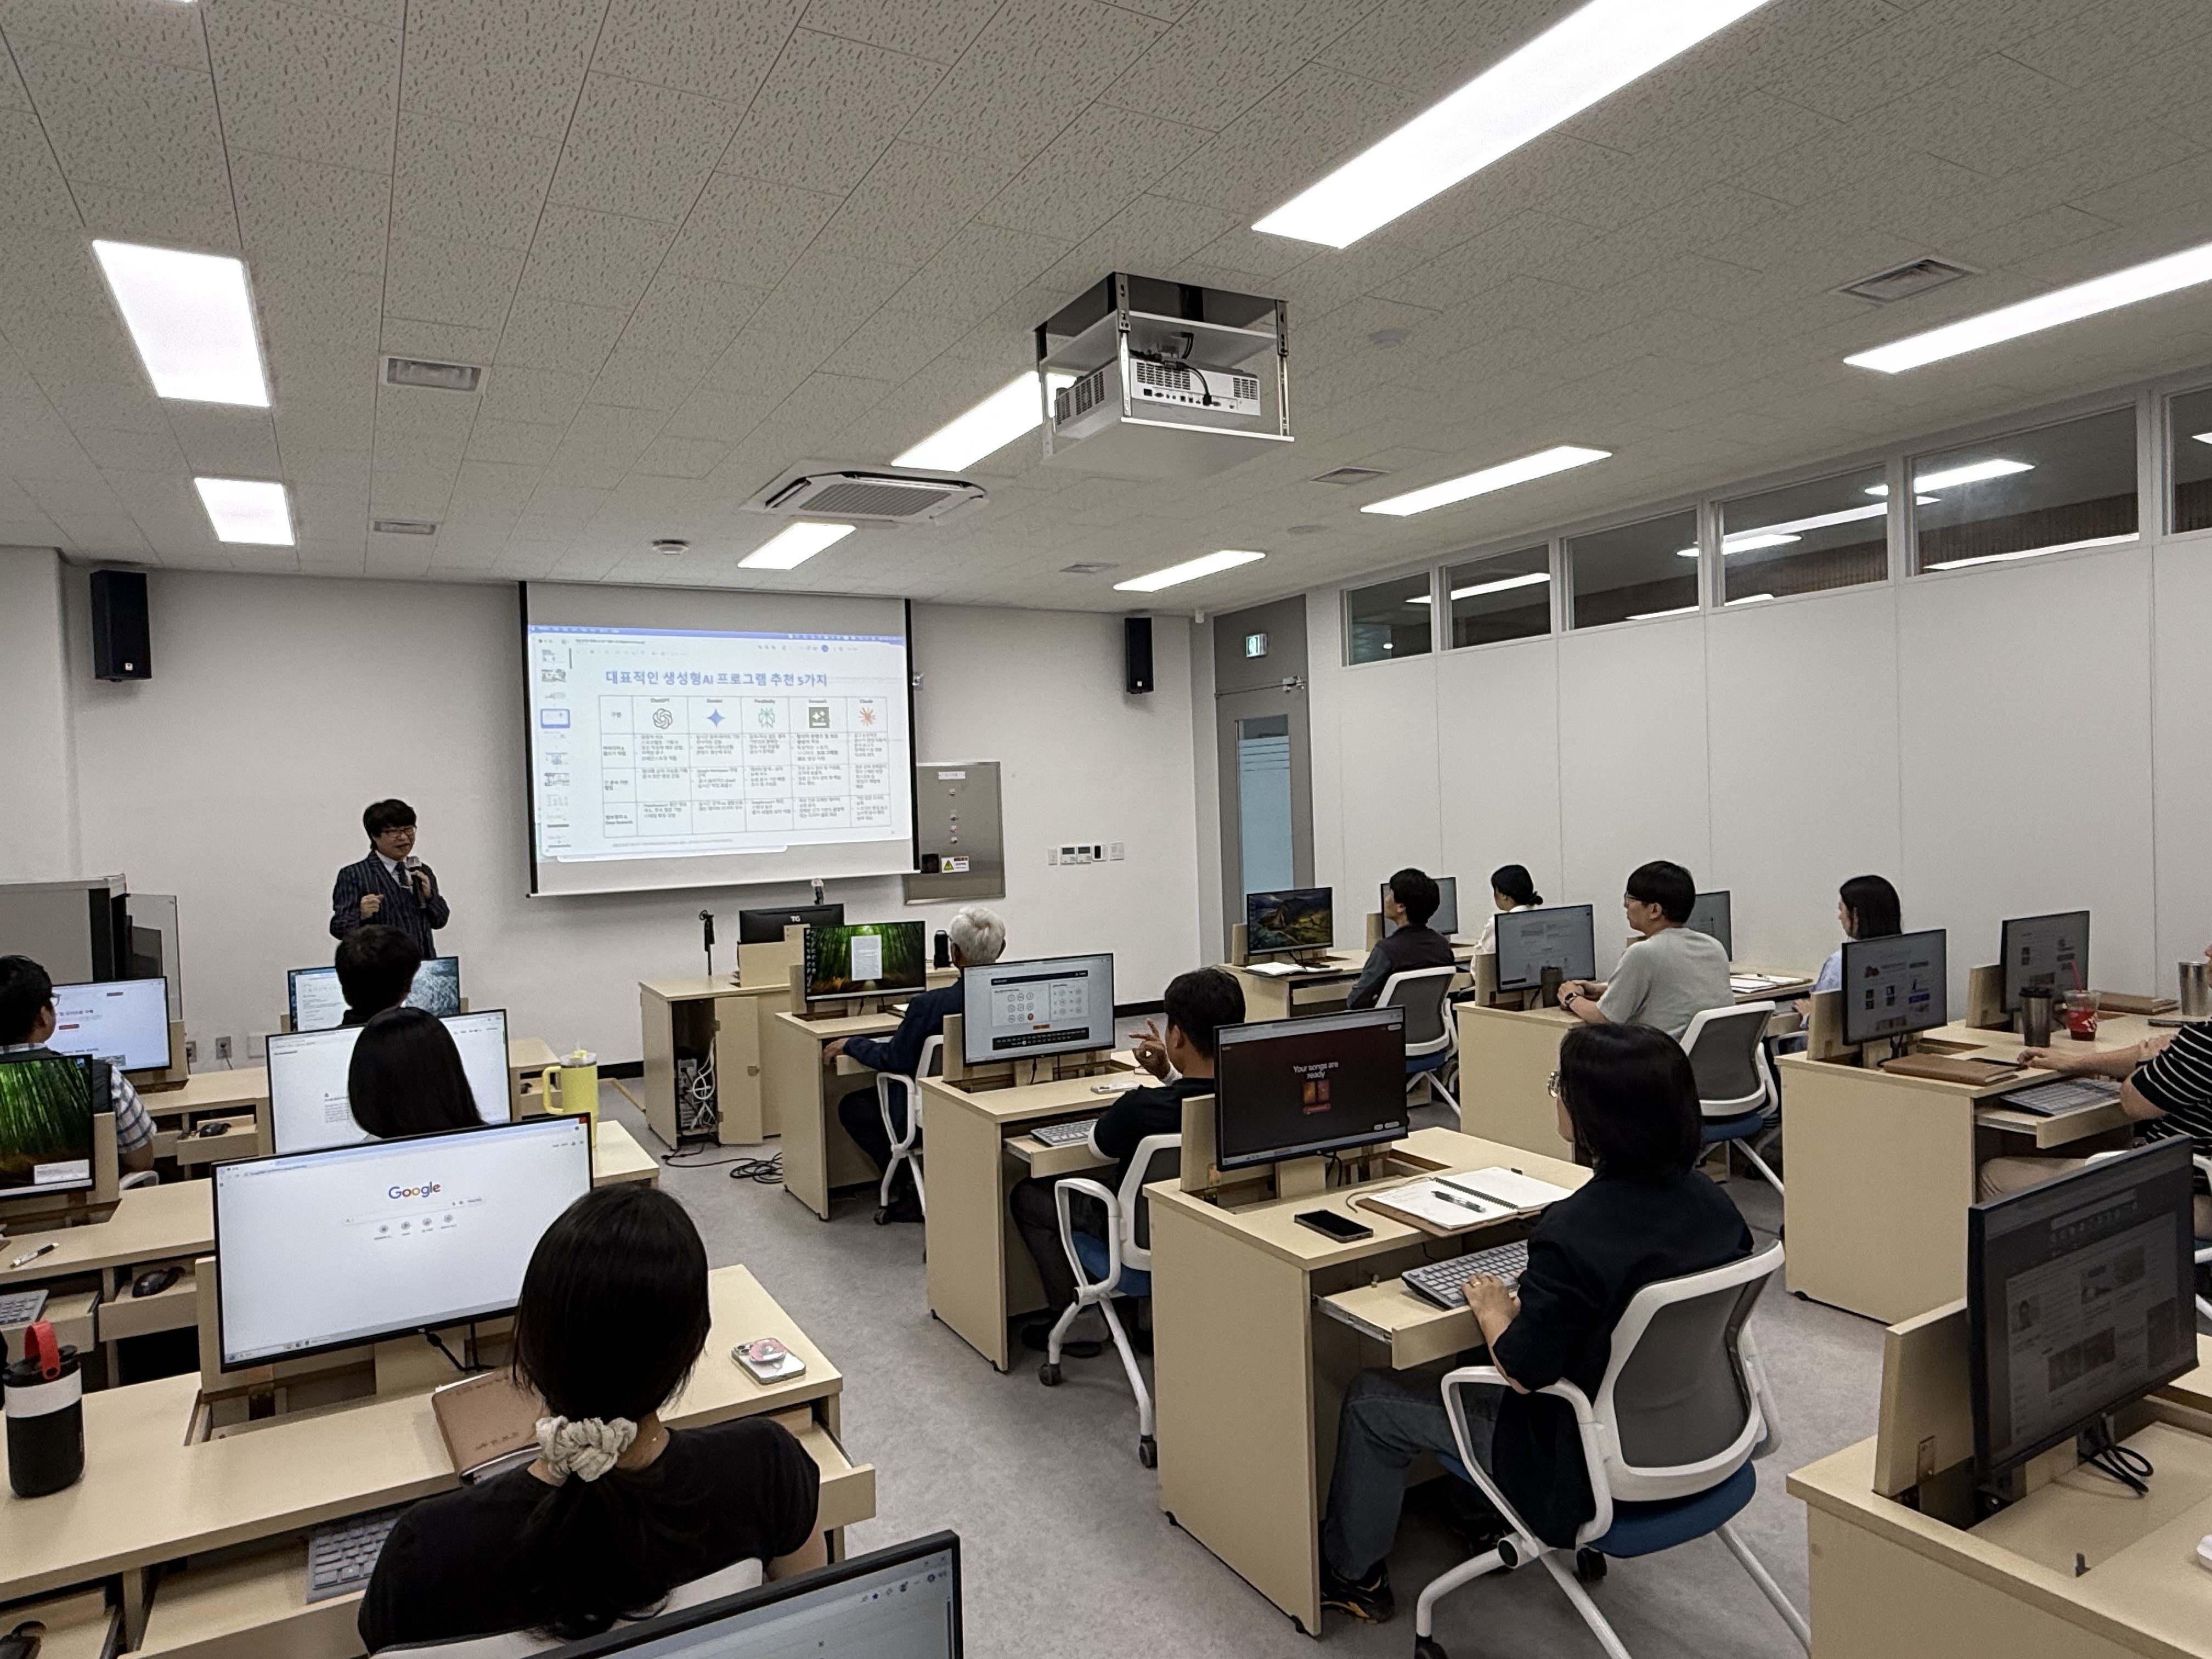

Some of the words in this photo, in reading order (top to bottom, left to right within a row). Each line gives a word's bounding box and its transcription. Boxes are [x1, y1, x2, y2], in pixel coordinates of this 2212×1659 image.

[605, 670, 658, 685] 대표적인
[663, 671, 713, 686] 생성형AI
[716, 672, 766, 686] 프로그램
[770, 673, 794, 686] 추천
[797, 674, 827, 687] 5가지
[388, 1181, 441, 1199] Google
